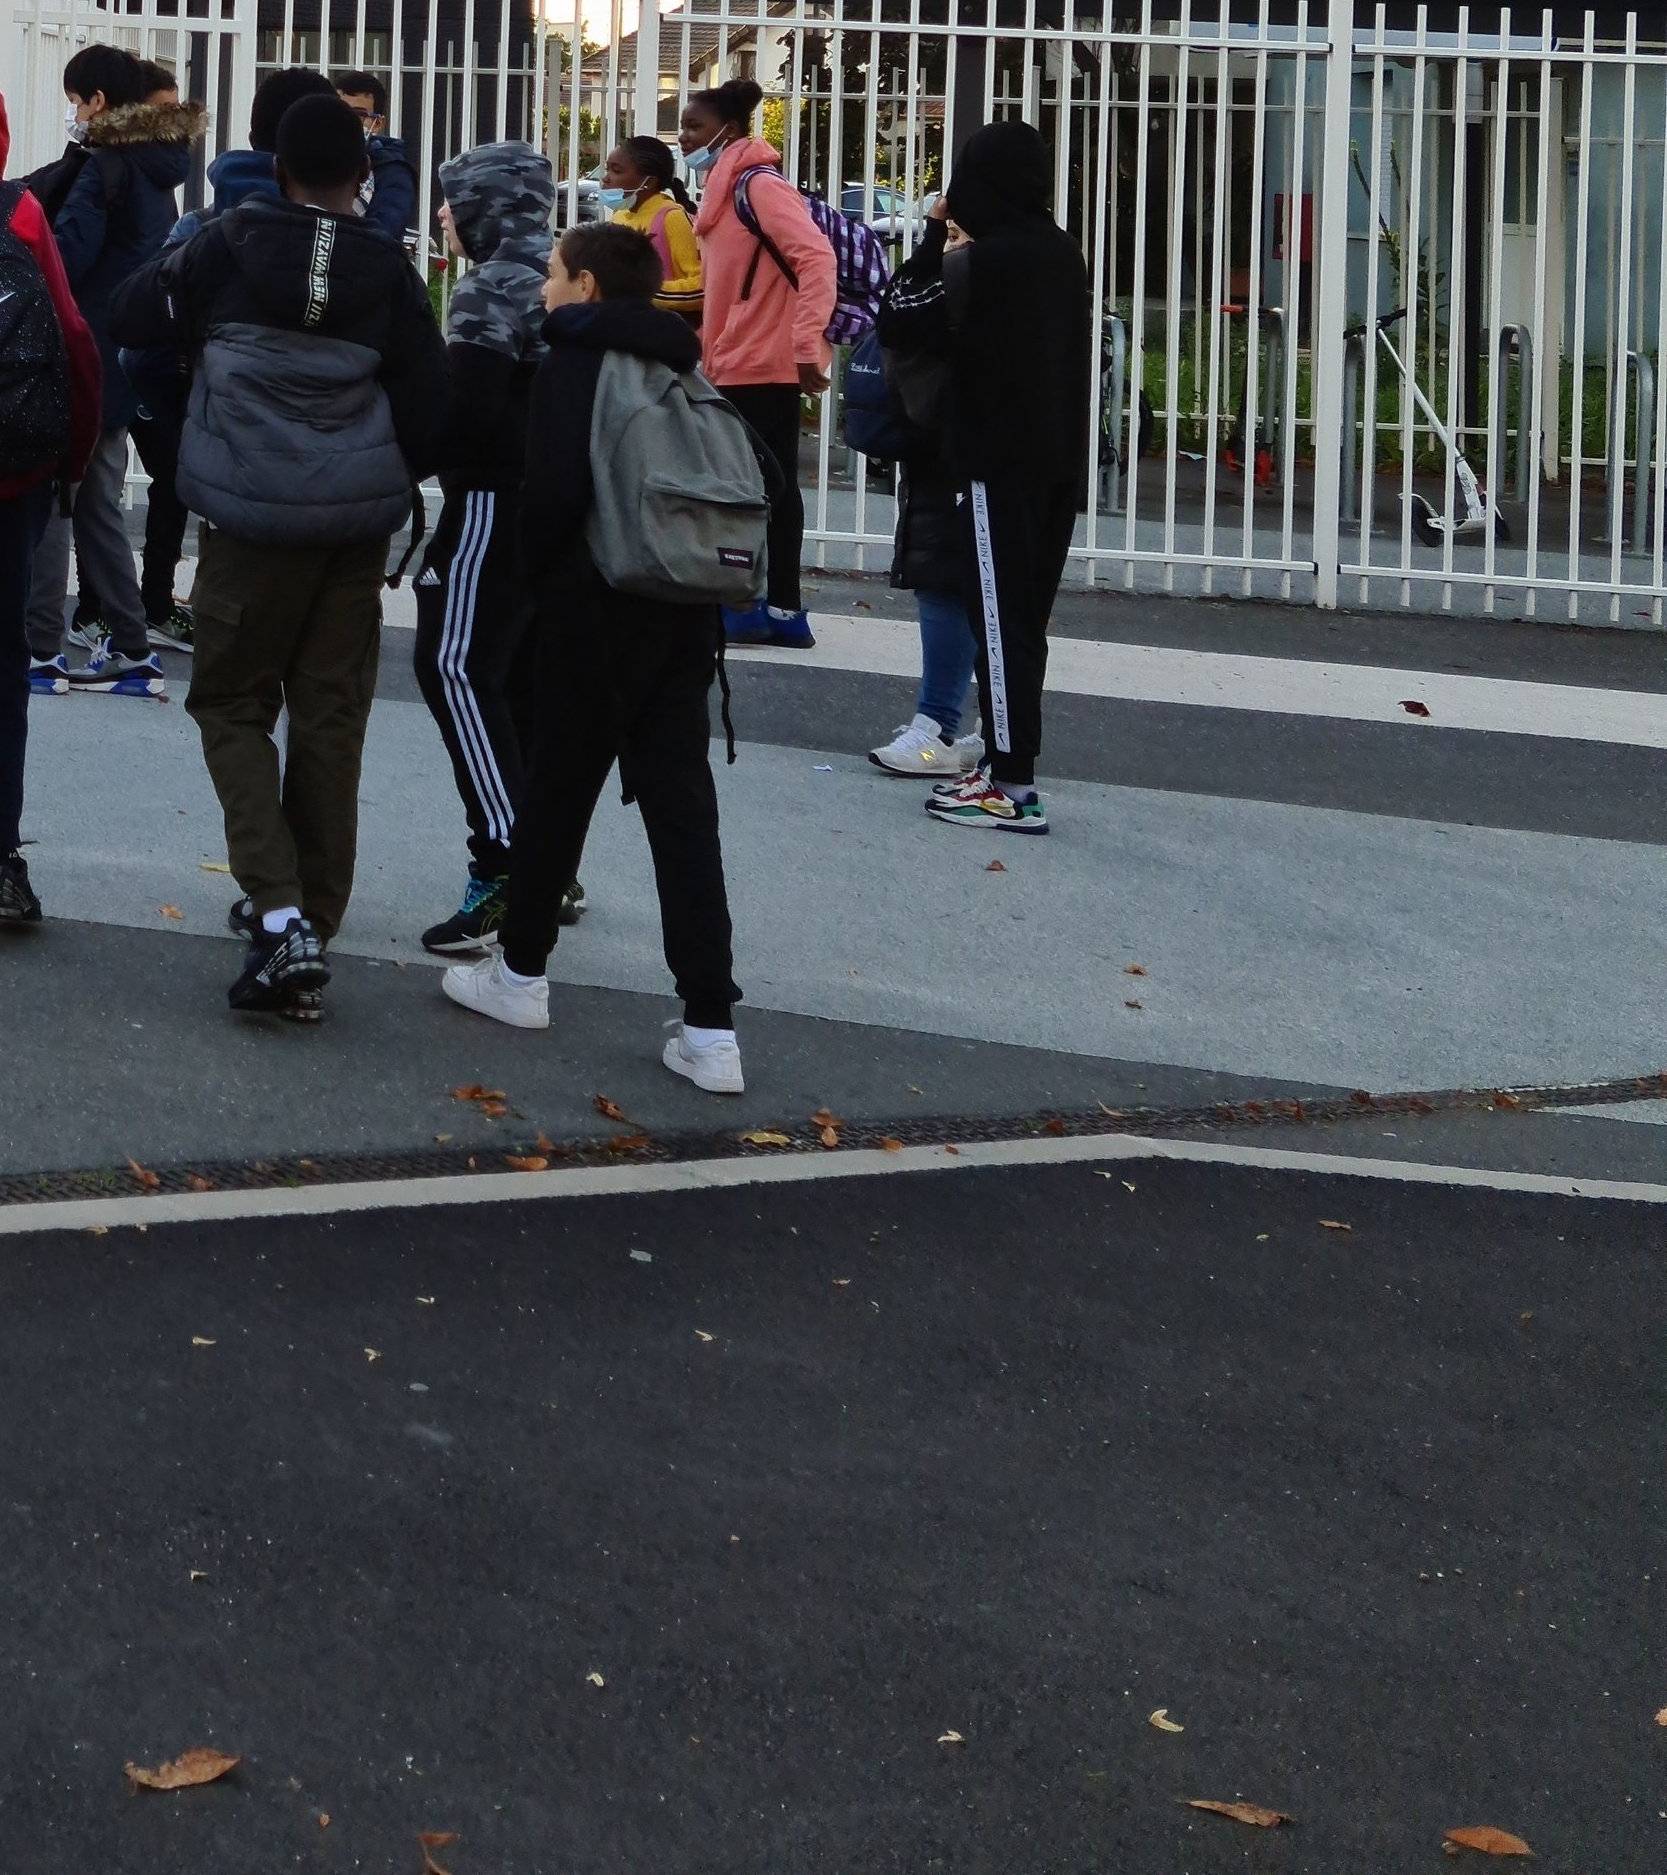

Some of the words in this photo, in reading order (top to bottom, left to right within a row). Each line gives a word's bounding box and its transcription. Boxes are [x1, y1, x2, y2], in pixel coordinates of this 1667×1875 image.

[974, 493, 985, 515] NIKE
[978, 536, 989, 558] NIKE
[983, 578, 994, 600] NIKE
[987, 622, 999, 644] NIKE
[991, 664, 1002, 687] NIKE
[994, 708, 1005, 730] NIKE
